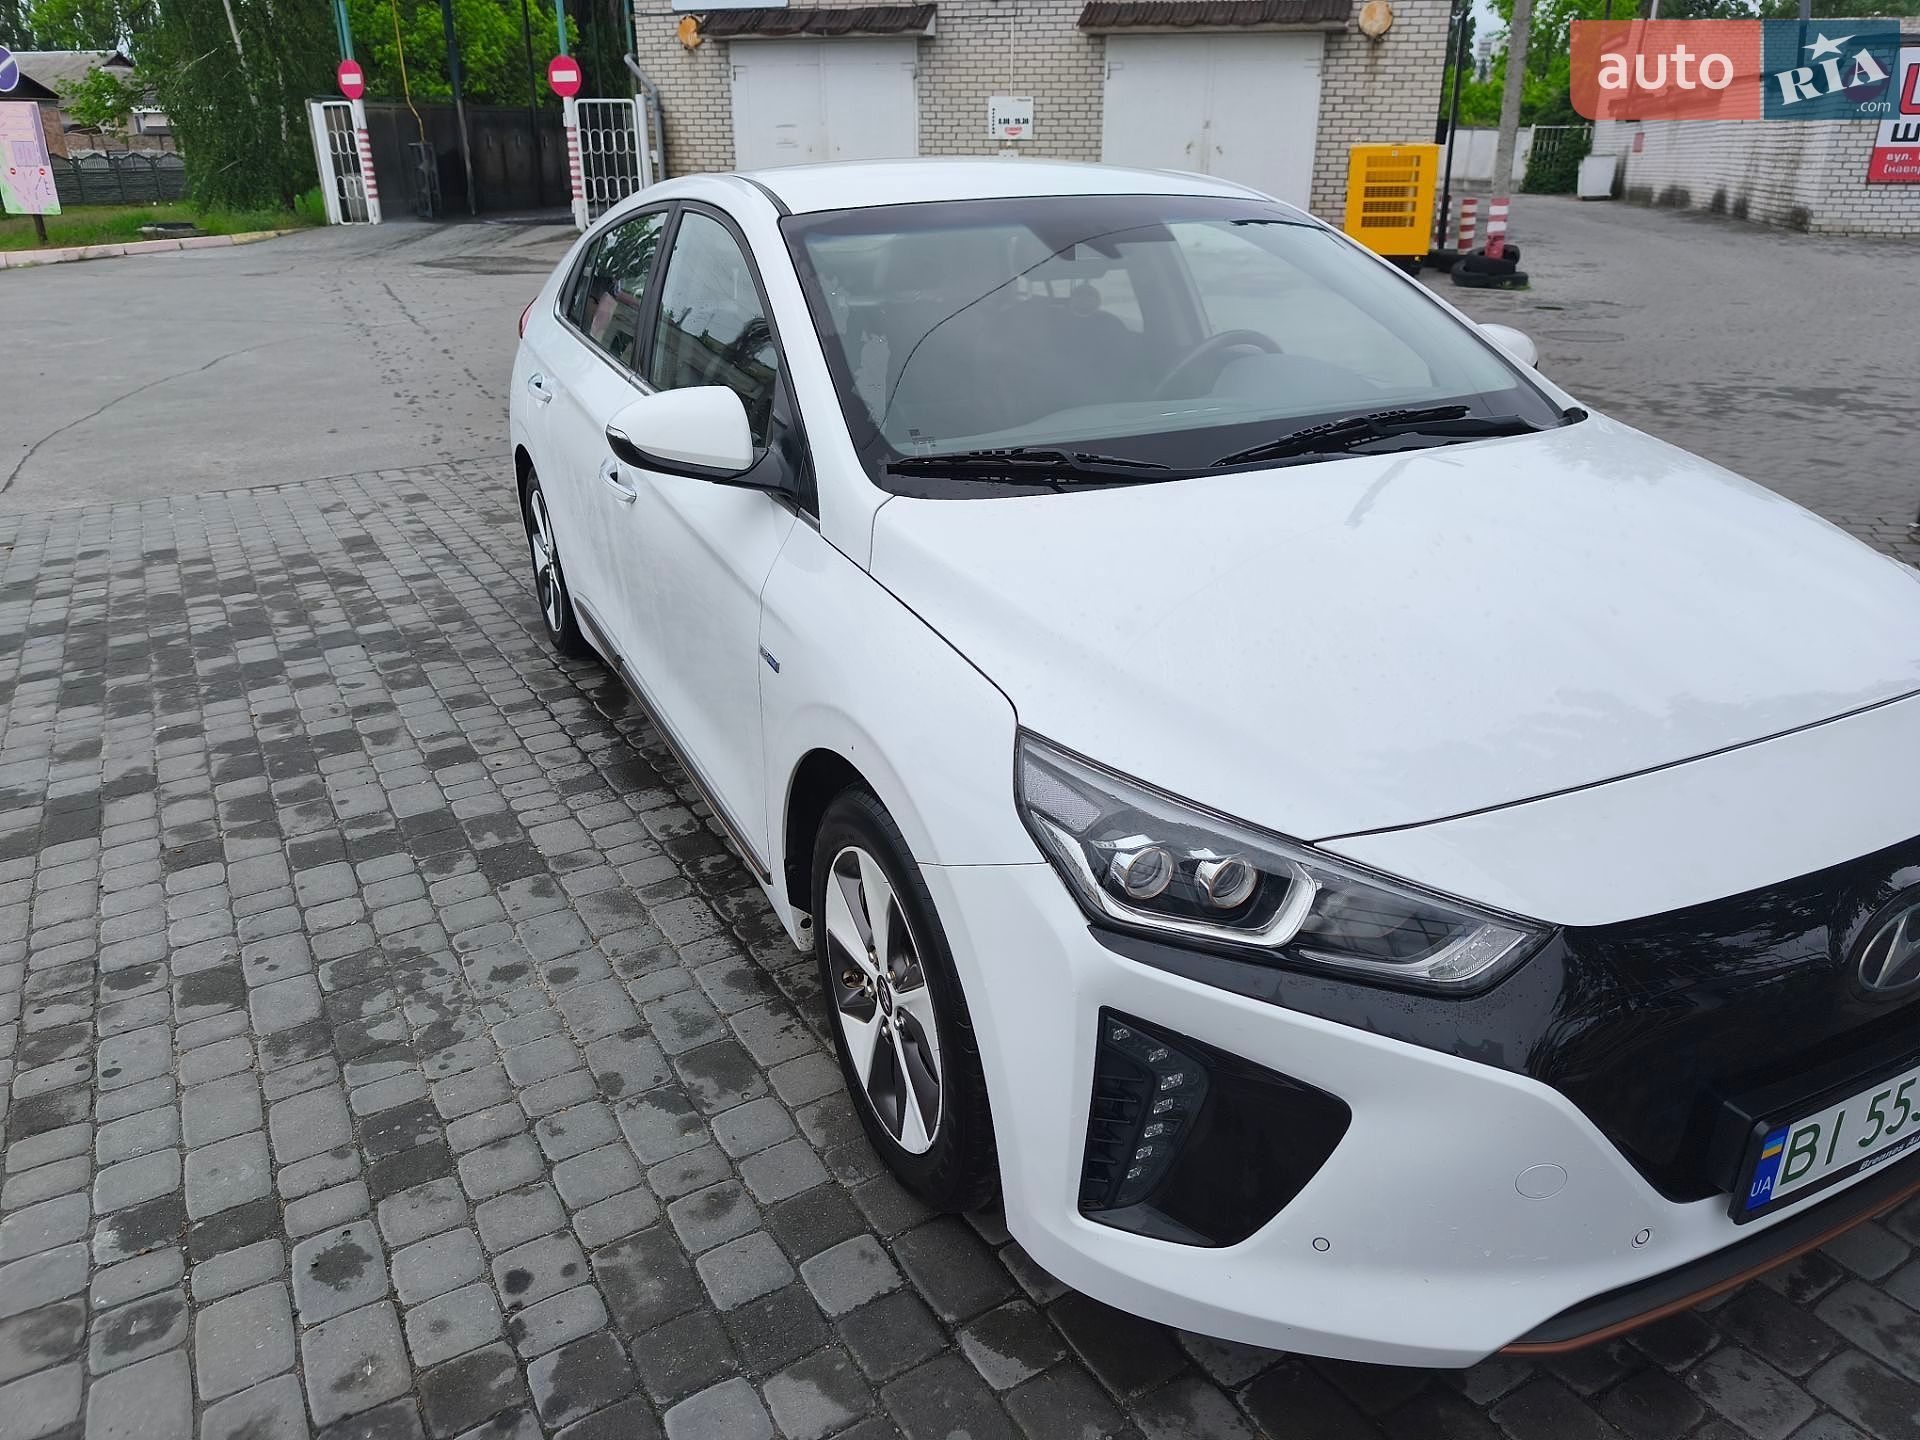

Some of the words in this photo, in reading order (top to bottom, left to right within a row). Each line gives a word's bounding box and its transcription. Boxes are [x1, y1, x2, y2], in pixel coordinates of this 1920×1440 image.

[1886, 153, 1912, 163] вул.
[1780, 1110, 1846, 1186] BI
[1857, 1077, 1920, 1148] 55
[1750, 1175, 1771, 1197] UA
